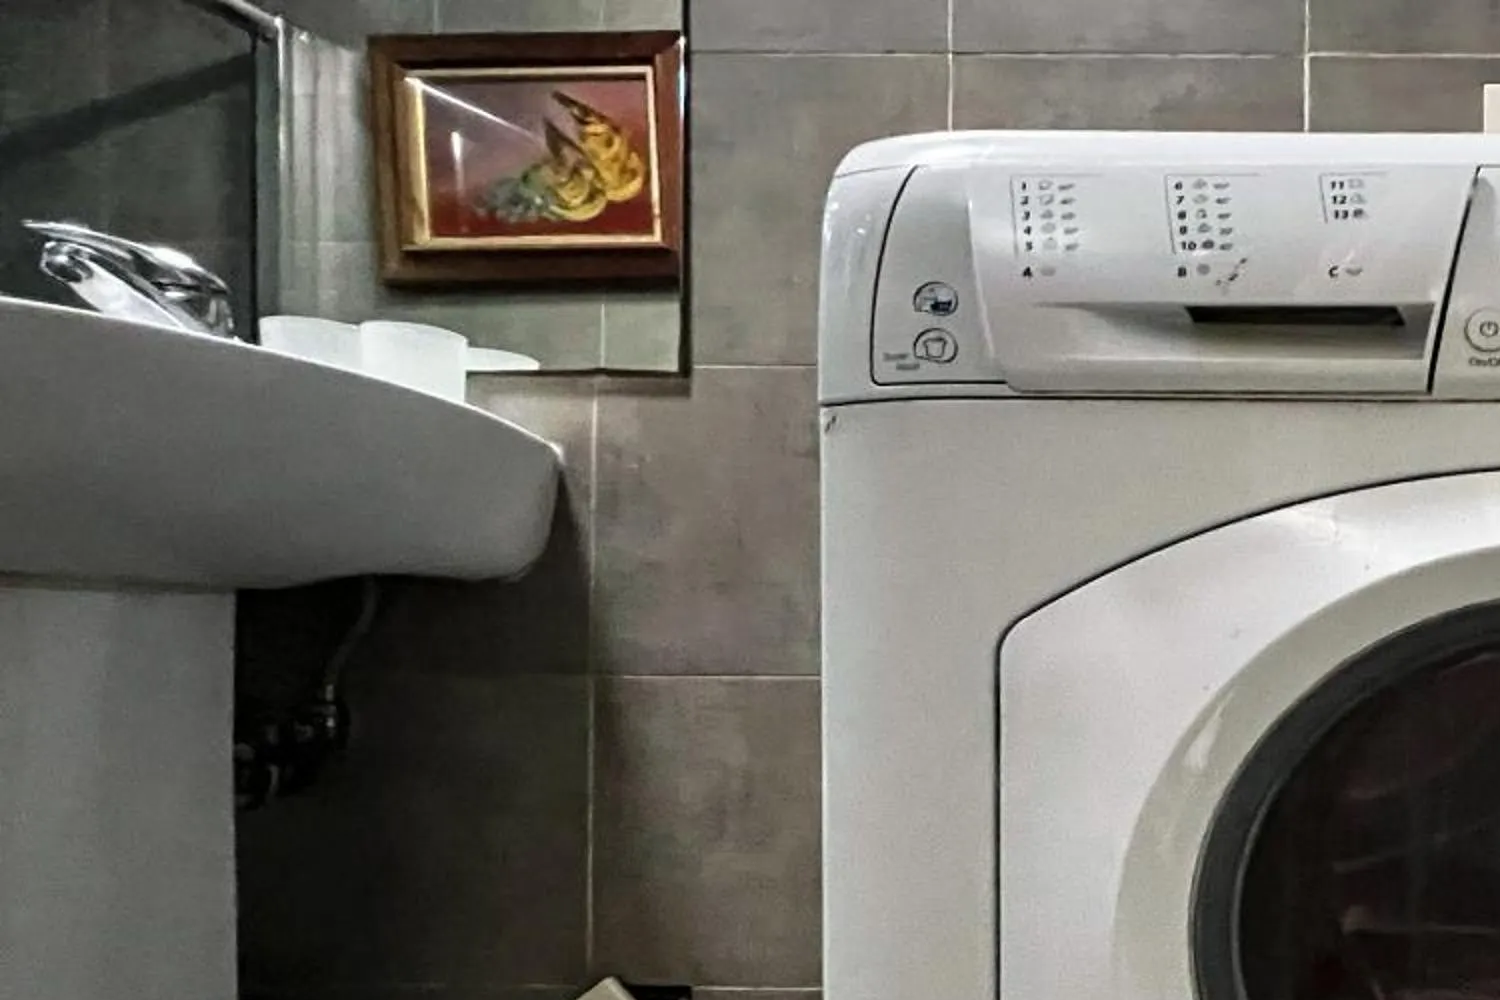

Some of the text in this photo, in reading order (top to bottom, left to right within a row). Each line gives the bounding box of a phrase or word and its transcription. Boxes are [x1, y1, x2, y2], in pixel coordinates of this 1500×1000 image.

[1332, 195, 1347, 205] 12
[1334, 209, 1349, 220] 13
[1181, 240, 1197, 251] 10
[1328, 265, 1339, 279] C
